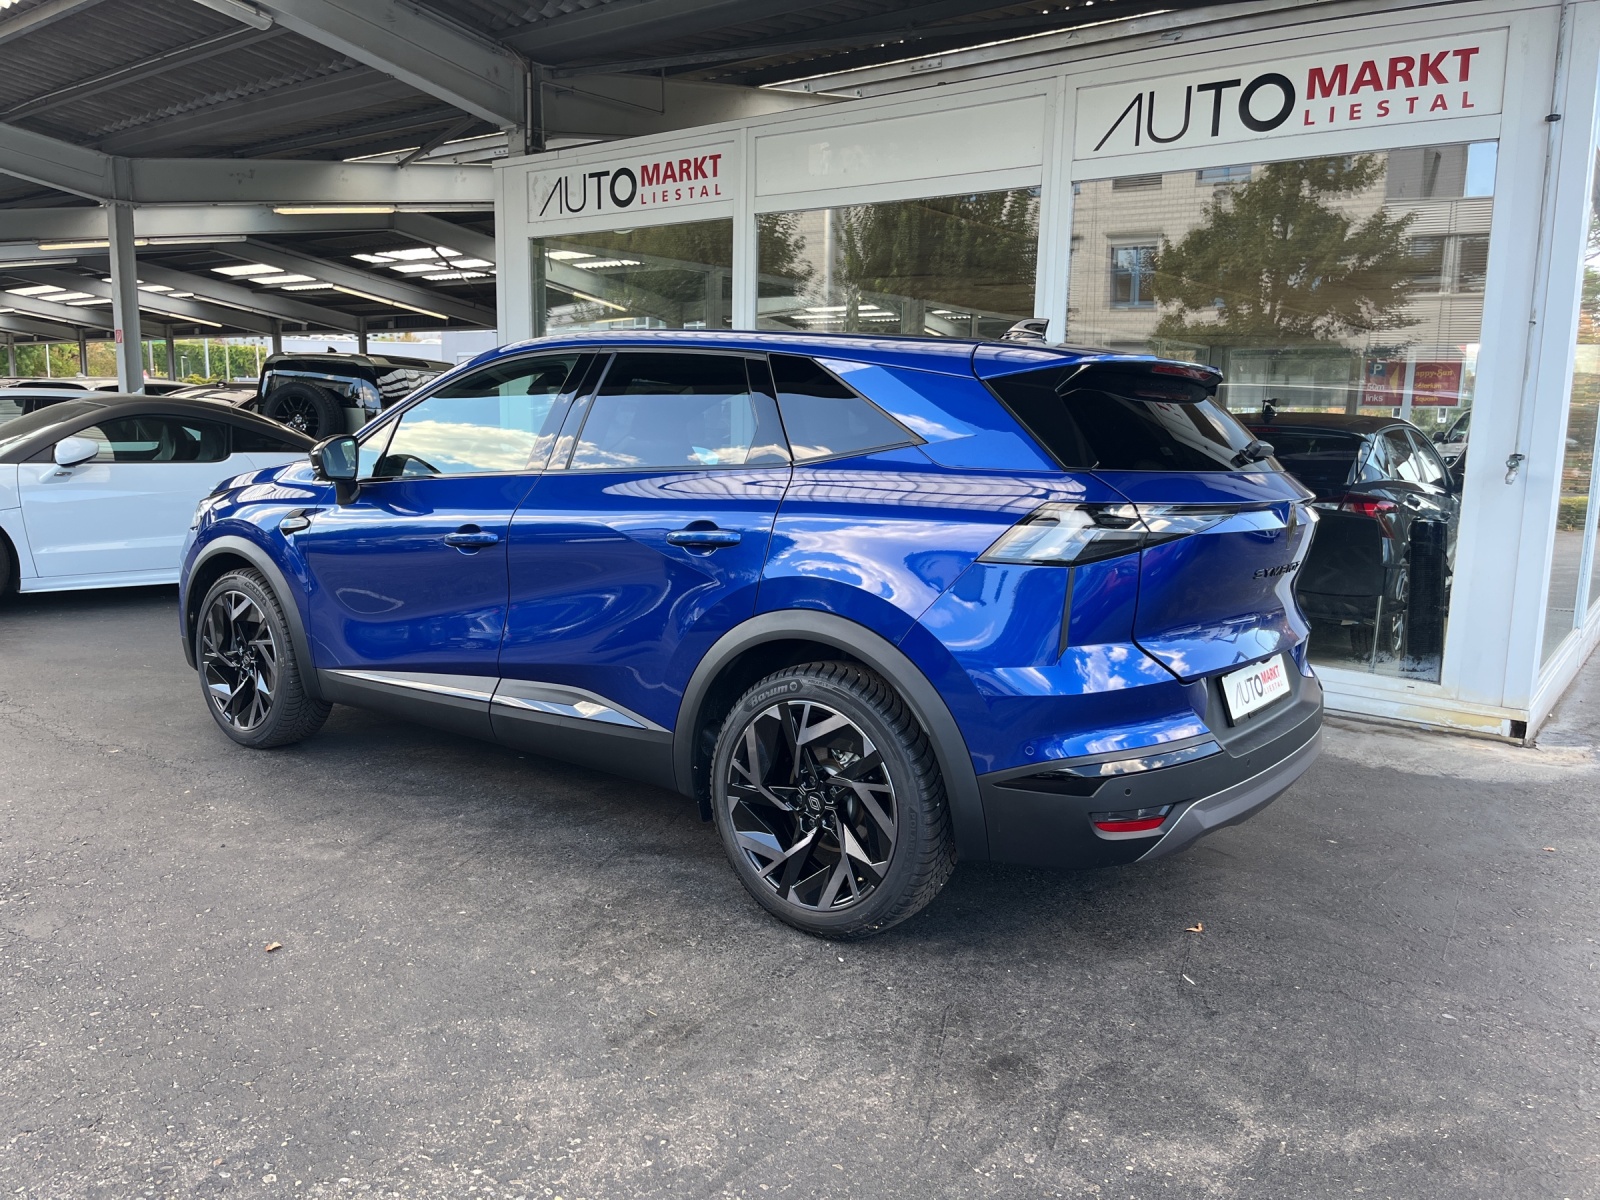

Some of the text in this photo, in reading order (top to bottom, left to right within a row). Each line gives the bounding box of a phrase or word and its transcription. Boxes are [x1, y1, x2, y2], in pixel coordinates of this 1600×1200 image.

[1093, 47, 1480, 152] AUTO MARKT
[1303, 91, 1475, 126] LIESTAL
[539, 153, 722, 216] AUTO MARKT
[640, 184, 722, 205] LIESTAL
[1373, 363, 1383, 375] P
[1415, 369, 1453, 378] appy-Sun
[1365, 393, 1384, 402] links
[750, 684, 788, 708] Barum
[1235, 664, 1280, 709] AUTO MARKT
[1263, 680, 1283, 695] LIESTAL
